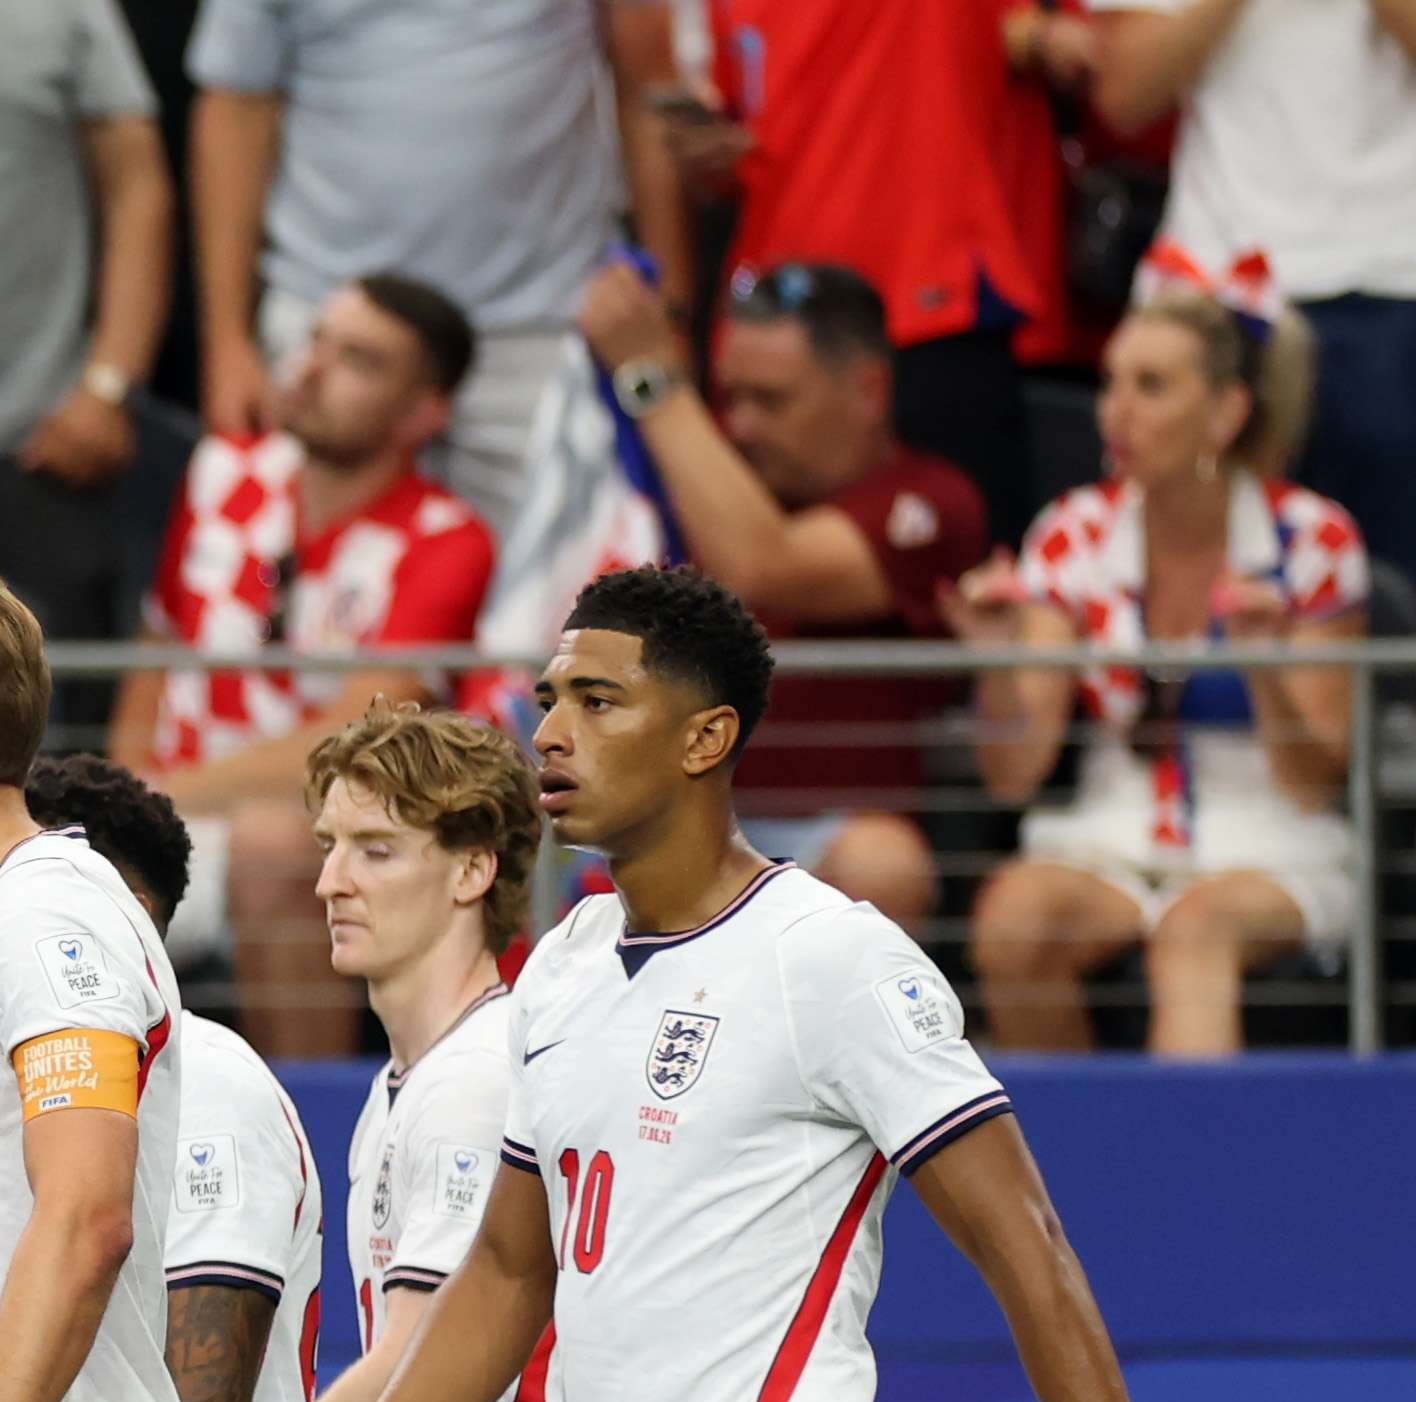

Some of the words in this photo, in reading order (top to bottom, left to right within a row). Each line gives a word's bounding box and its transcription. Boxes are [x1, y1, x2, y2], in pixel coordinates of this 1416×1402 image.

[67, 973, 101, 991] PEACE
[23, 1036, 93, 1063] FOOTBALL
[23, 1050, 94, 1084] UNITES
[44, 1069, 100, 1095] World
[41, 1095, 69, 1109] FIFA
[638, 1105, 679, 1126] CROATIA
[189, 1181, 223, 1198] PEACE
[558, 1147, 615, 1275] 10
